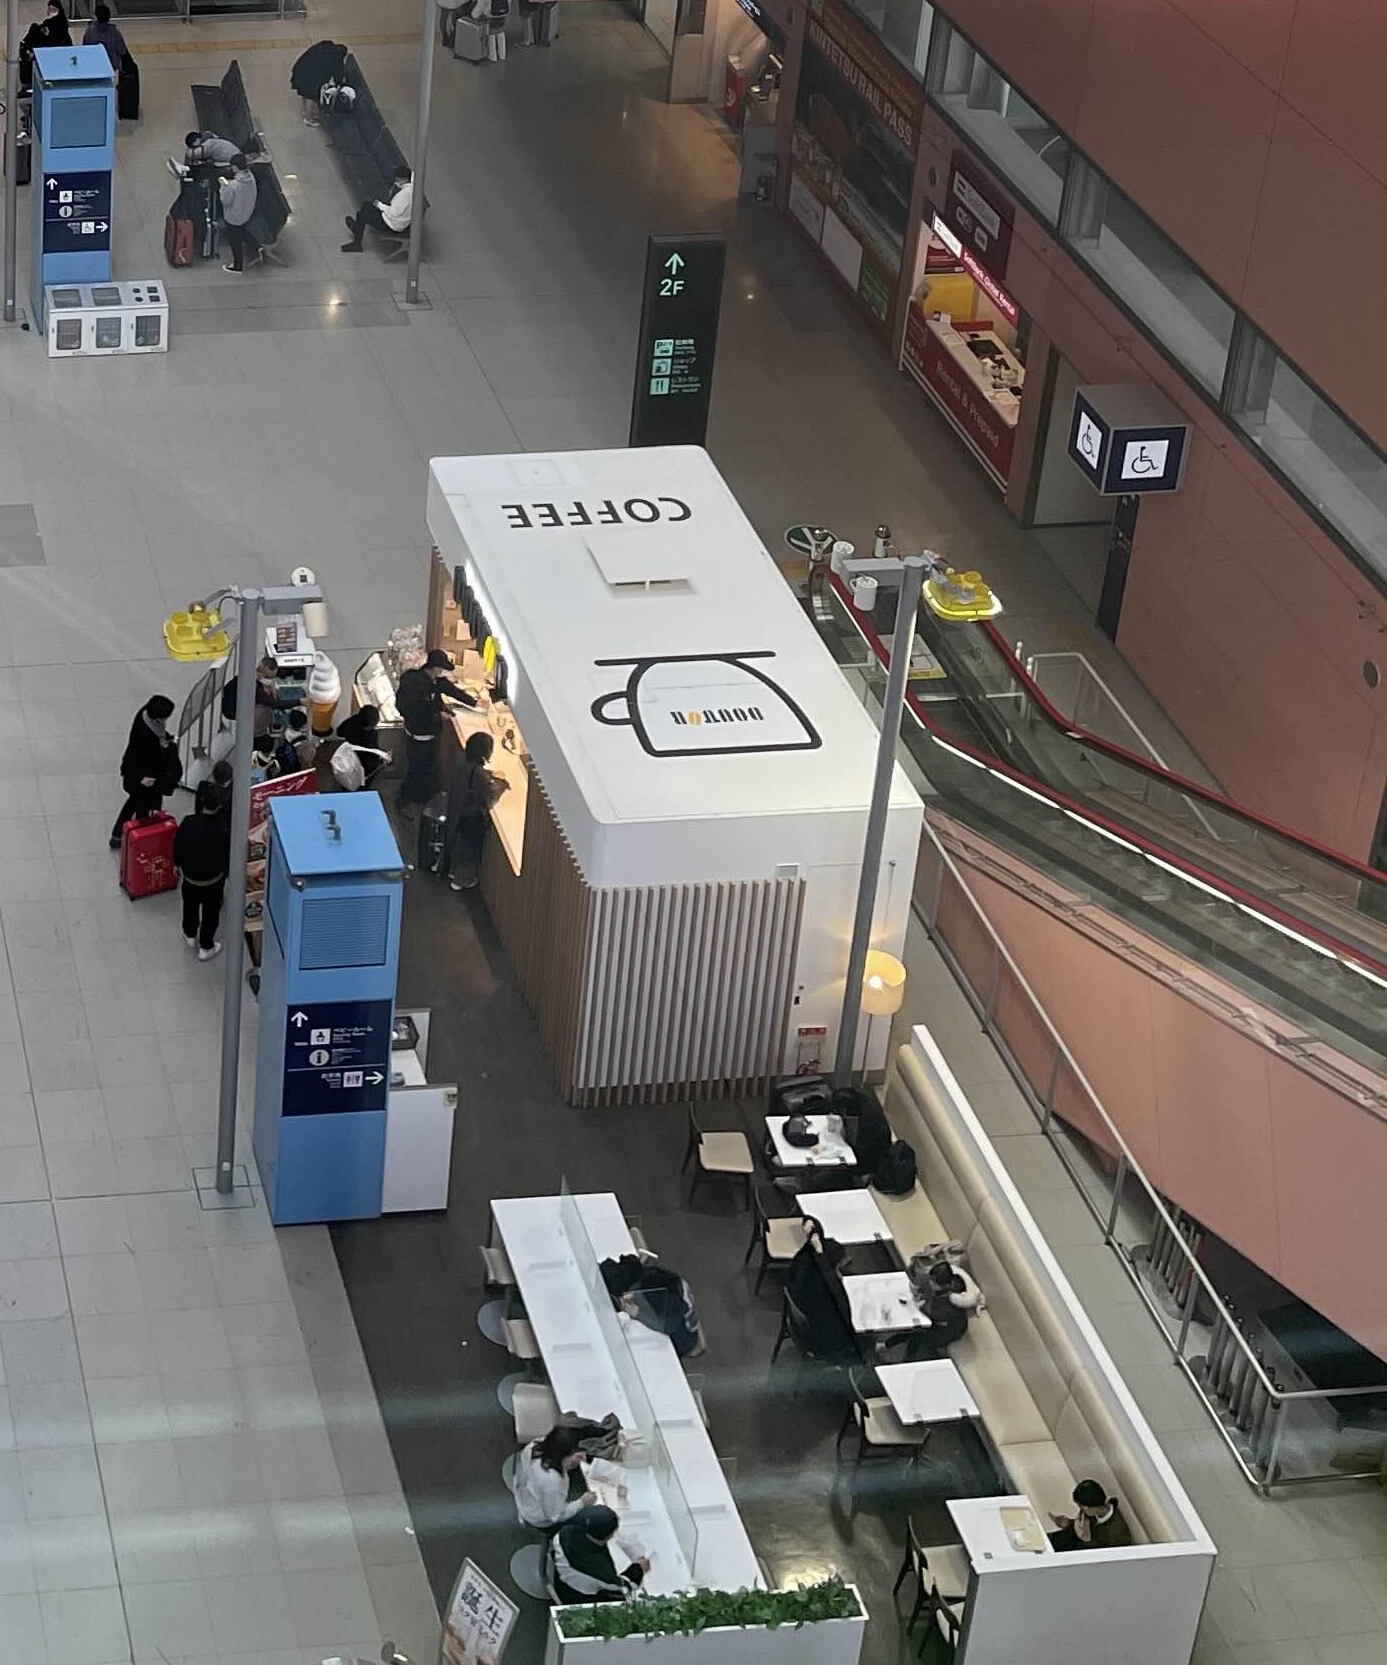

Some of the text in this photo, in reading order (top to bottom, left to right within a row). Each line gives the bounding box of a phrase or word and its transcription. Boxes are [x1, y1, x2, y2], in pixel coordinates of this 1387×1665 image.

[810, 19, 913, 146] KINTETSU RAIL PASS
[659, 278, 685, 296] 2F
[501, 497, 692, 529] COFFEE
[670, 707, 764, 726] DOUTOR
